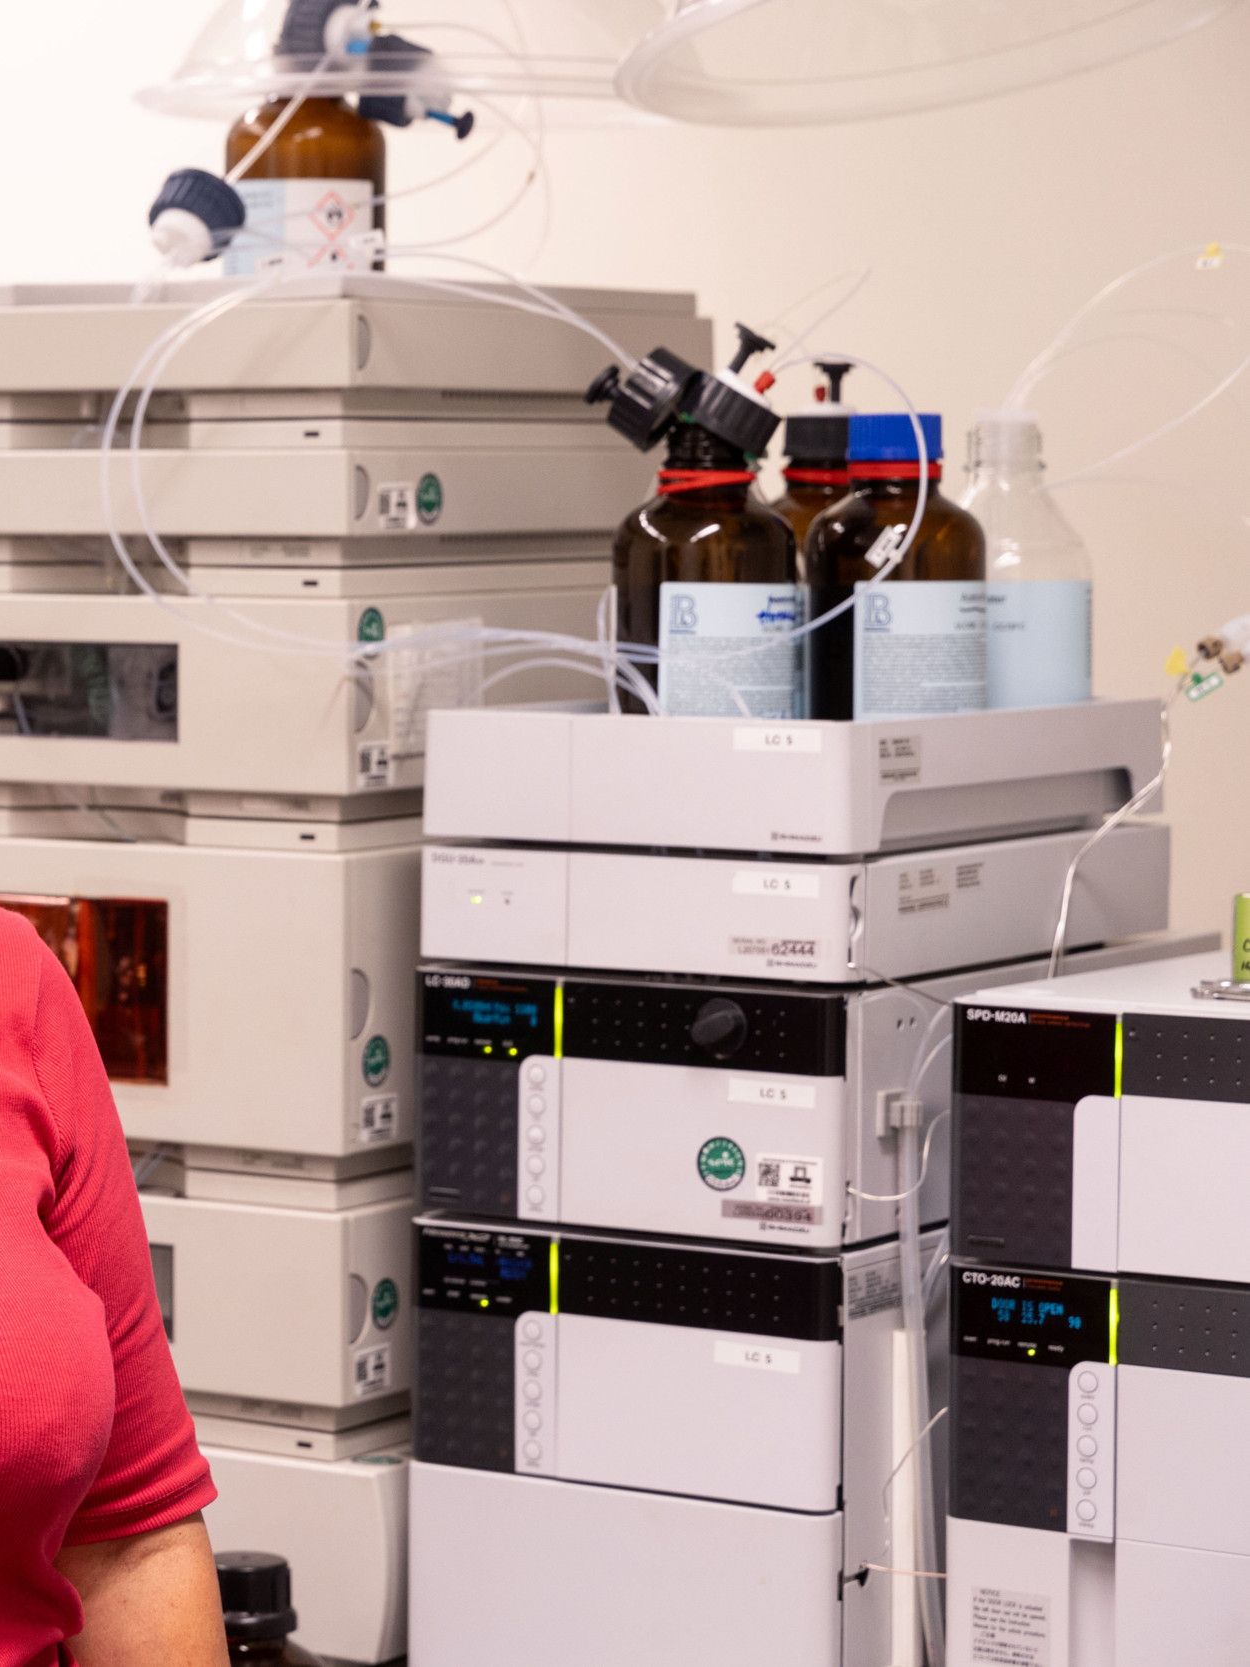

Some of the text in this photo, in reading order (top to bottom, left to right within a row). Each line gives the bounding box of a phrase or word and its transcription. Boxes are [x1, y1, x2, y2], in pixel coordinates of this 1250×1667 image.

[765, 734, 781, 745] LC
[763, 879, 778, 889] LC
[966, 1008, 1027, 1025] SPD-M20A
[759, 1088, 775, 1099] LC
[962, 1271, 1021, 1288] CTO-20AC
[1038, 1302, 1064, 1315] OPEN
